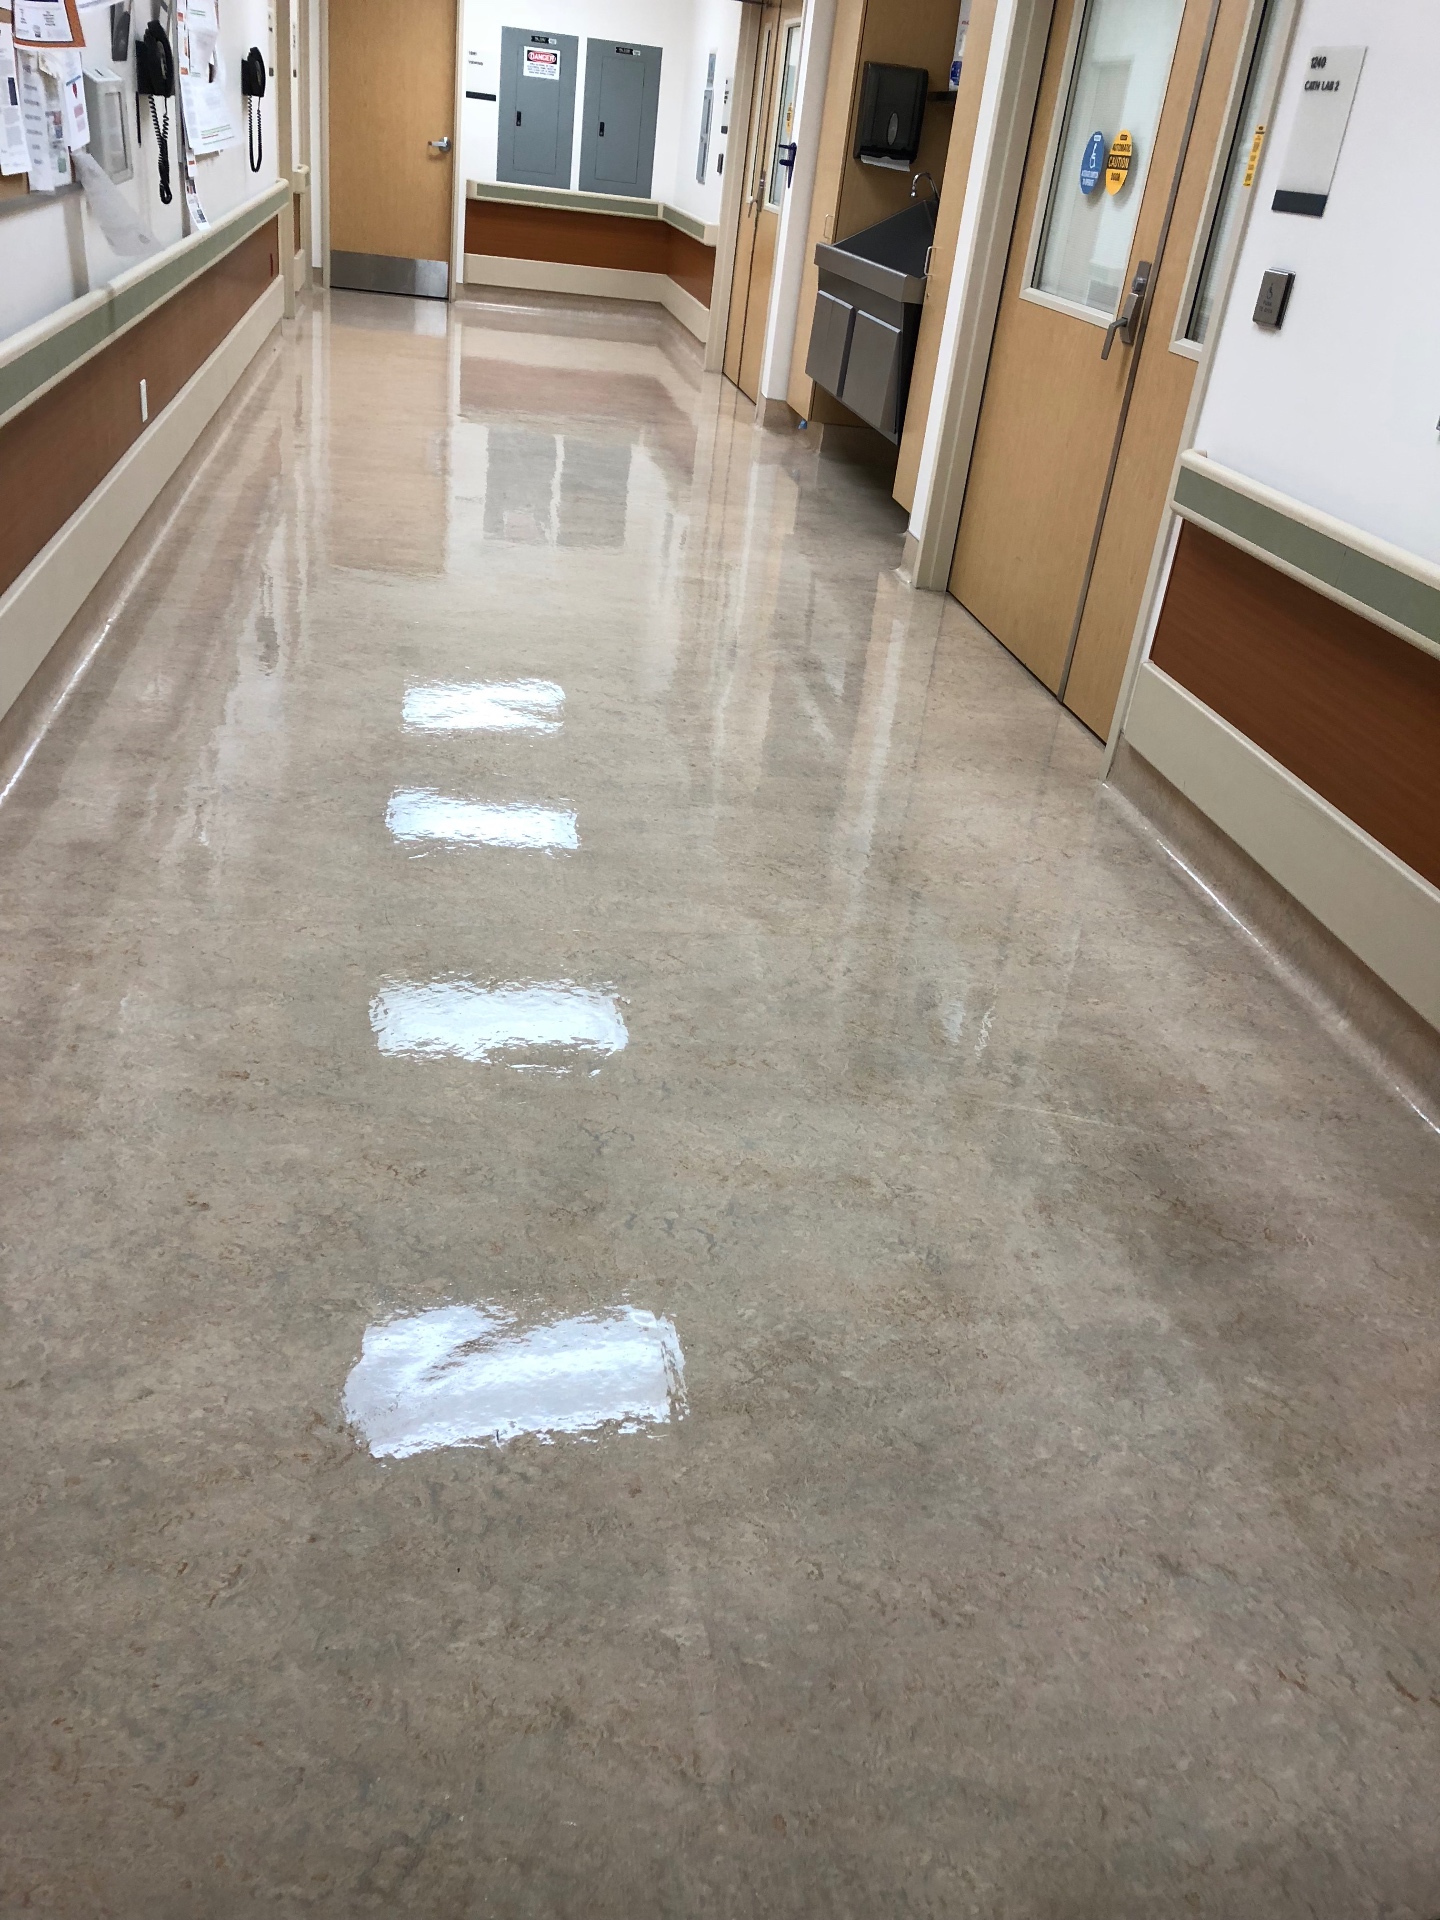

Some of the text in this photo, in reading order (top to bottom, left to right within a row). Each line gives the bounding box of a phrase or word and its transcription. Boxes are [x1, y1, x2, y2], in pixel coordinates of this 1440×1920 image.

[529, 51, 556, 62] DANGER
[1304, 80, 1340, 92] CATH LAB 2
[1112, 144, 1132, 152] AUTOMATIC
[1108, 156, 1130, 168] CAUTION
[1110, 173, 1121, 181] DOOR
